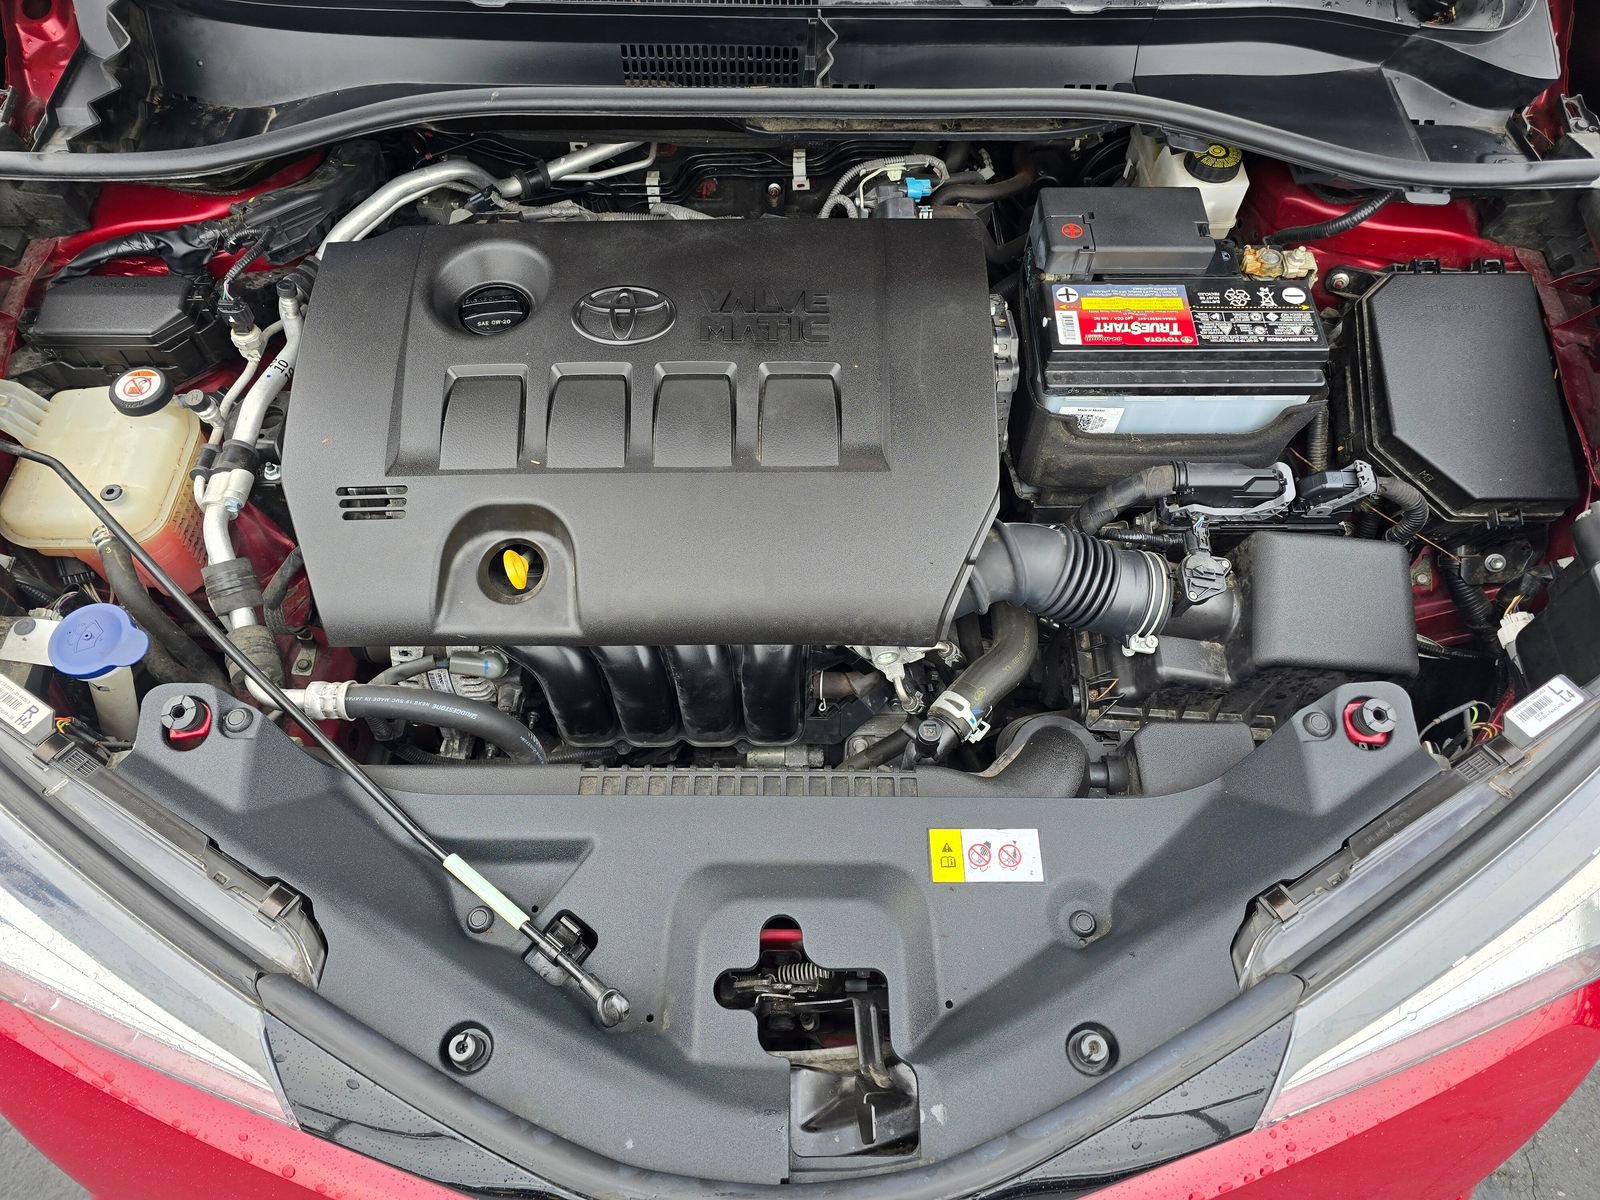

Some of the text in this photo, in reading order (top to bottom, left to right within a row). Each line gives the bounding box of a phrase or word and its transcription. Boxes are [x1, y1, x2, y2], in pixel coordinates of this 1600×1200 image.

[699, 288, 829, 314] VALVE
[699, 315, 829, 343] MATIC
[274, 359, 289, 373] 10
[1547, 685, 1563, 696] L
[23, 704, 39, 720] R
[431, 703, 478, 720] BRIDGESTONE
[14, 714, 32, 730] H4
